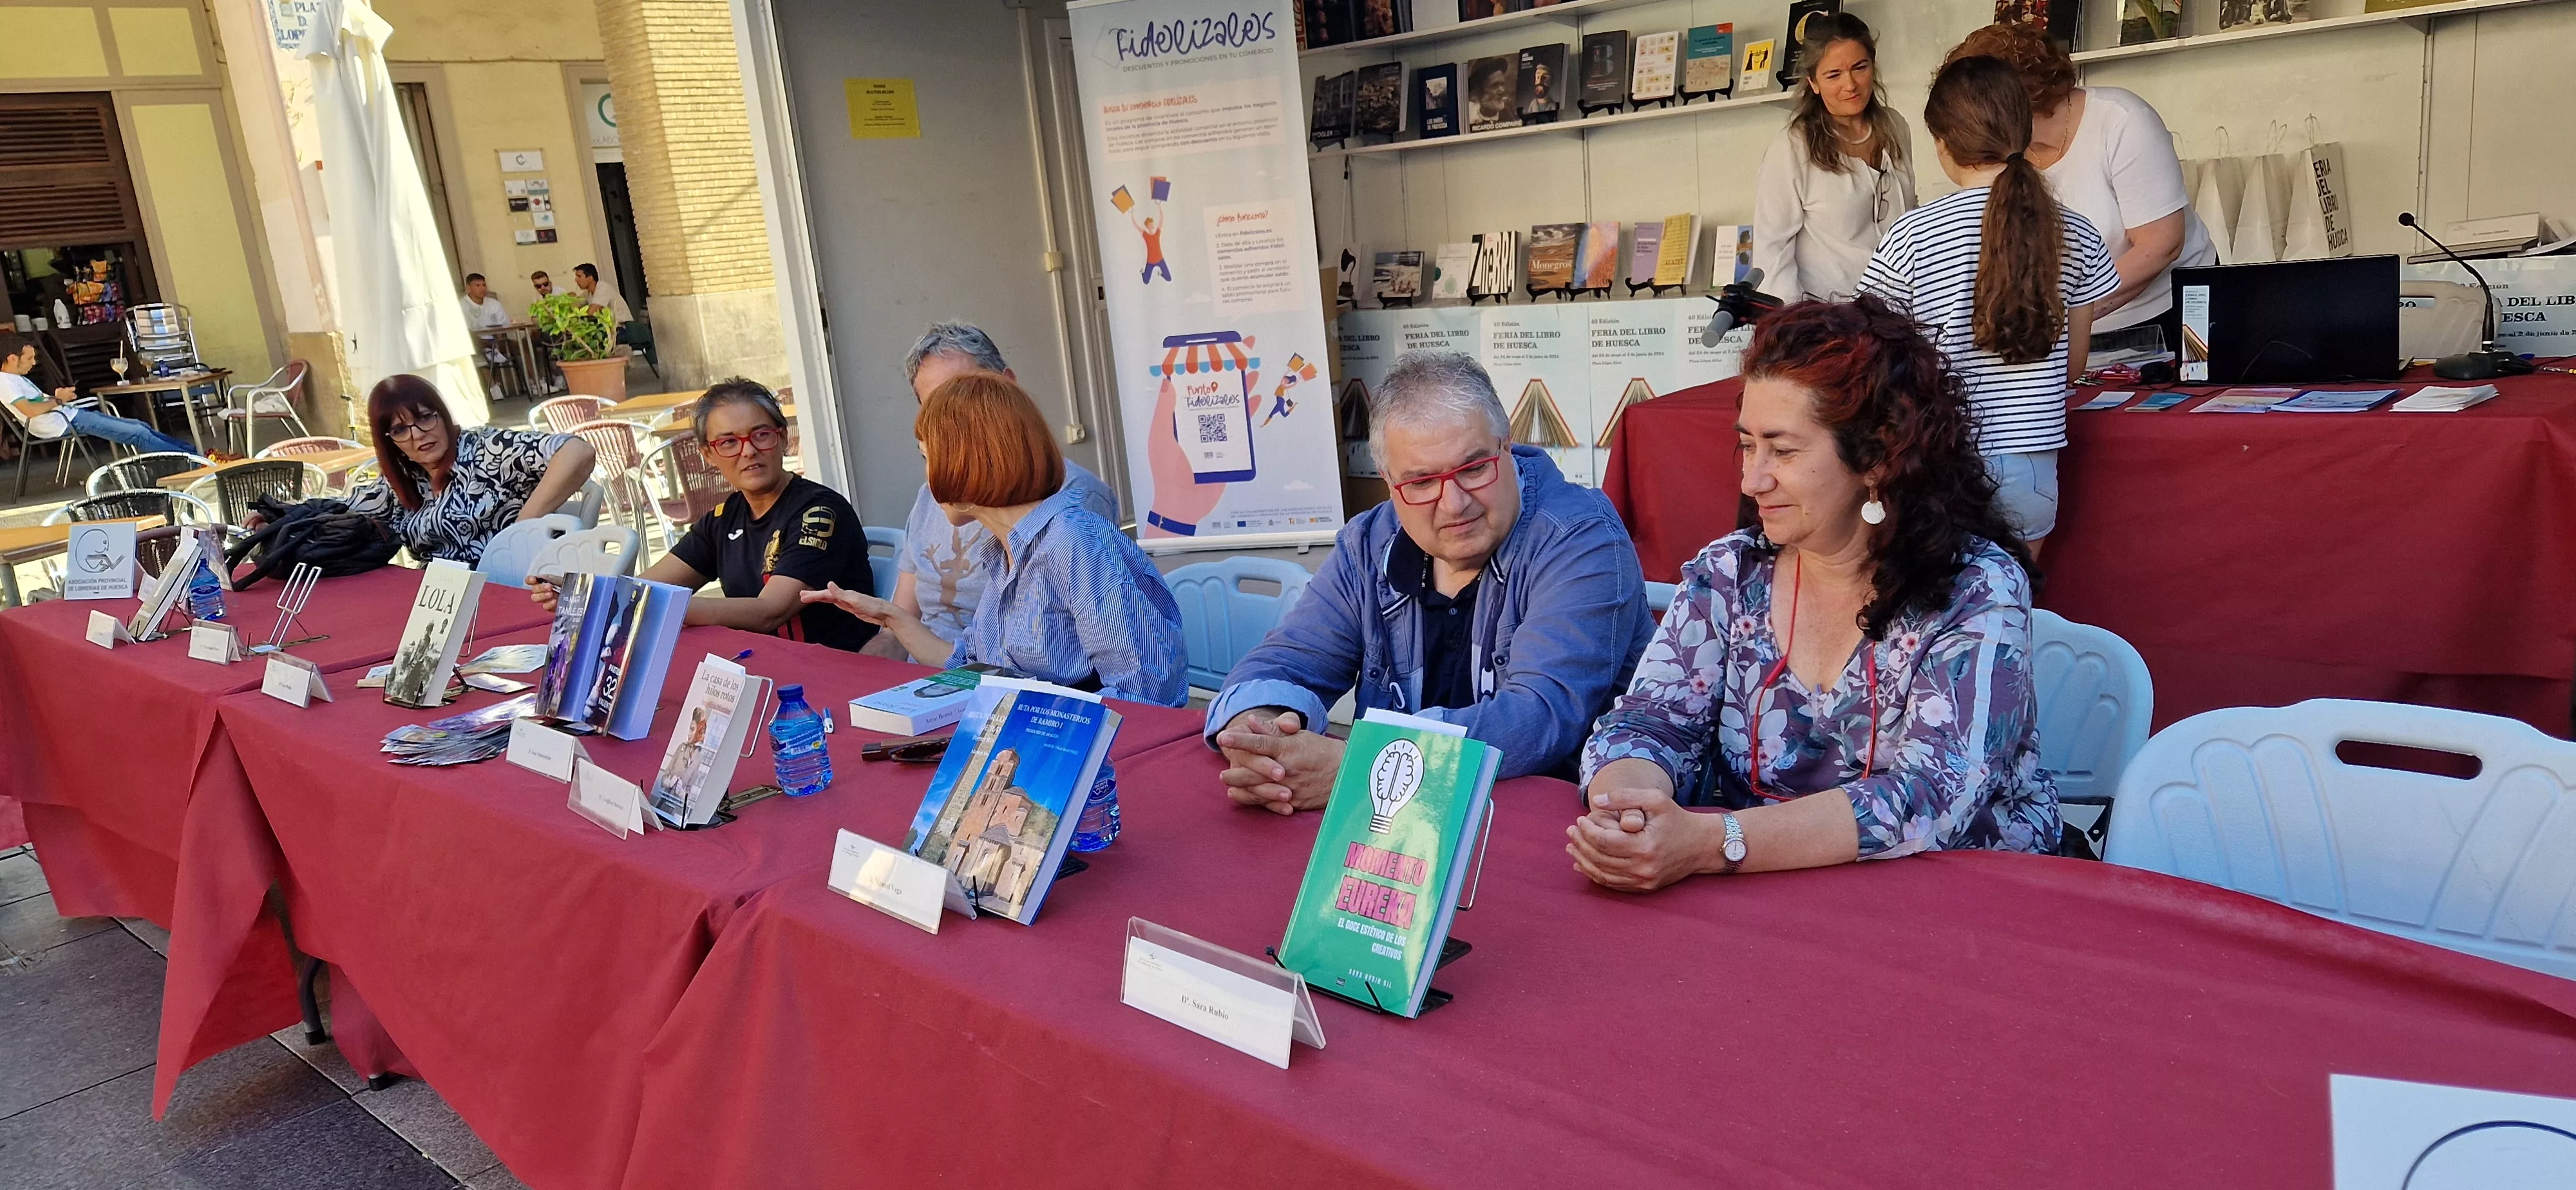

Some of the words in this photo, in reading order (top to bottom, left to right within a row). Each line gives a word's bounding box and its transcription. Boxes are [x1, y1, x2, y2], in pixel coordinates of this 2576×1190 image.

[294, 2, 321, 12] PLA
[279, 29, 307, 40] LOP
[1110, 12, 1276, 61] Fidelizales
[1122, 62, 1164, 72] DESCUENTOS
[1170, 53, 1217, 66] PROMOCIONES
[1238, 47, 1274, 58] COMERCIO
[1472, 122, 1494, 131] RICARDO
[2313, 157, 2332, 178] ERIA
[2324, 214, 2335, 233] DE
[1531, 259, 1572, 271] Monegros
[2507, 296, 2541, 307] DEL
[2545, 294, 2576, 307] LIB
[2501, 311, 2547, 323] ESCA
[1405, 332, 1430, 341] FERIA
[1536, 330, 1561, 339] LIBRO
[1638, 327, 1666, 335] LIBRO
[1687, 325, 1706, 334] FER
[1419, 340, 1450, 348] HUESCA
[1605, 339, 1641, 348] HUESCA
[1688, 337, 1701, 345] DE
[1718, 335, 1743, 344] ESCA
[1187, 383, 1211, 396] Punto
[1186, 393, 1240, 408] Fidelizales
[417, 585, 456, 614] LOLA
[603, 675, 618, 700] 32
[701, 669, 710, 681] La
[710, 675, 723, 685] casa
[723, 677, 730, 688] de
[730, 679, 740, 692] los
[705, 683, 720, 698] hilos
[720, 691, 735, 703] rotos
[1018, 703, 1030, 712] RUTA
[1030, 706, 1040, 714] POR
[1050, 708, 1092, 725] MONASTERIOS
[1030, 715, 1037, 724] DE
[1037, 717, 1059, 728] RAMIRO
[1059, 721, 1064, 730] I
[1343, 840, 1429, 887] MOMENTO
[1334, 874, 1418, 930] EUREKA
[1338, 917, 1345, 928] EL
[1360, 925, 1386, 941] ESTÉTICO
[1385, 932, 1396, 943] DE
[1395, 934, 1406, 947] LOS
[1371, 942, 1402, 961] CREATIVOS
[1348, 968, 1363, 979] SARA
[1191, 999, 1208, 1012] Sara
[1208, 1005, 1229, 1021] Rubio
